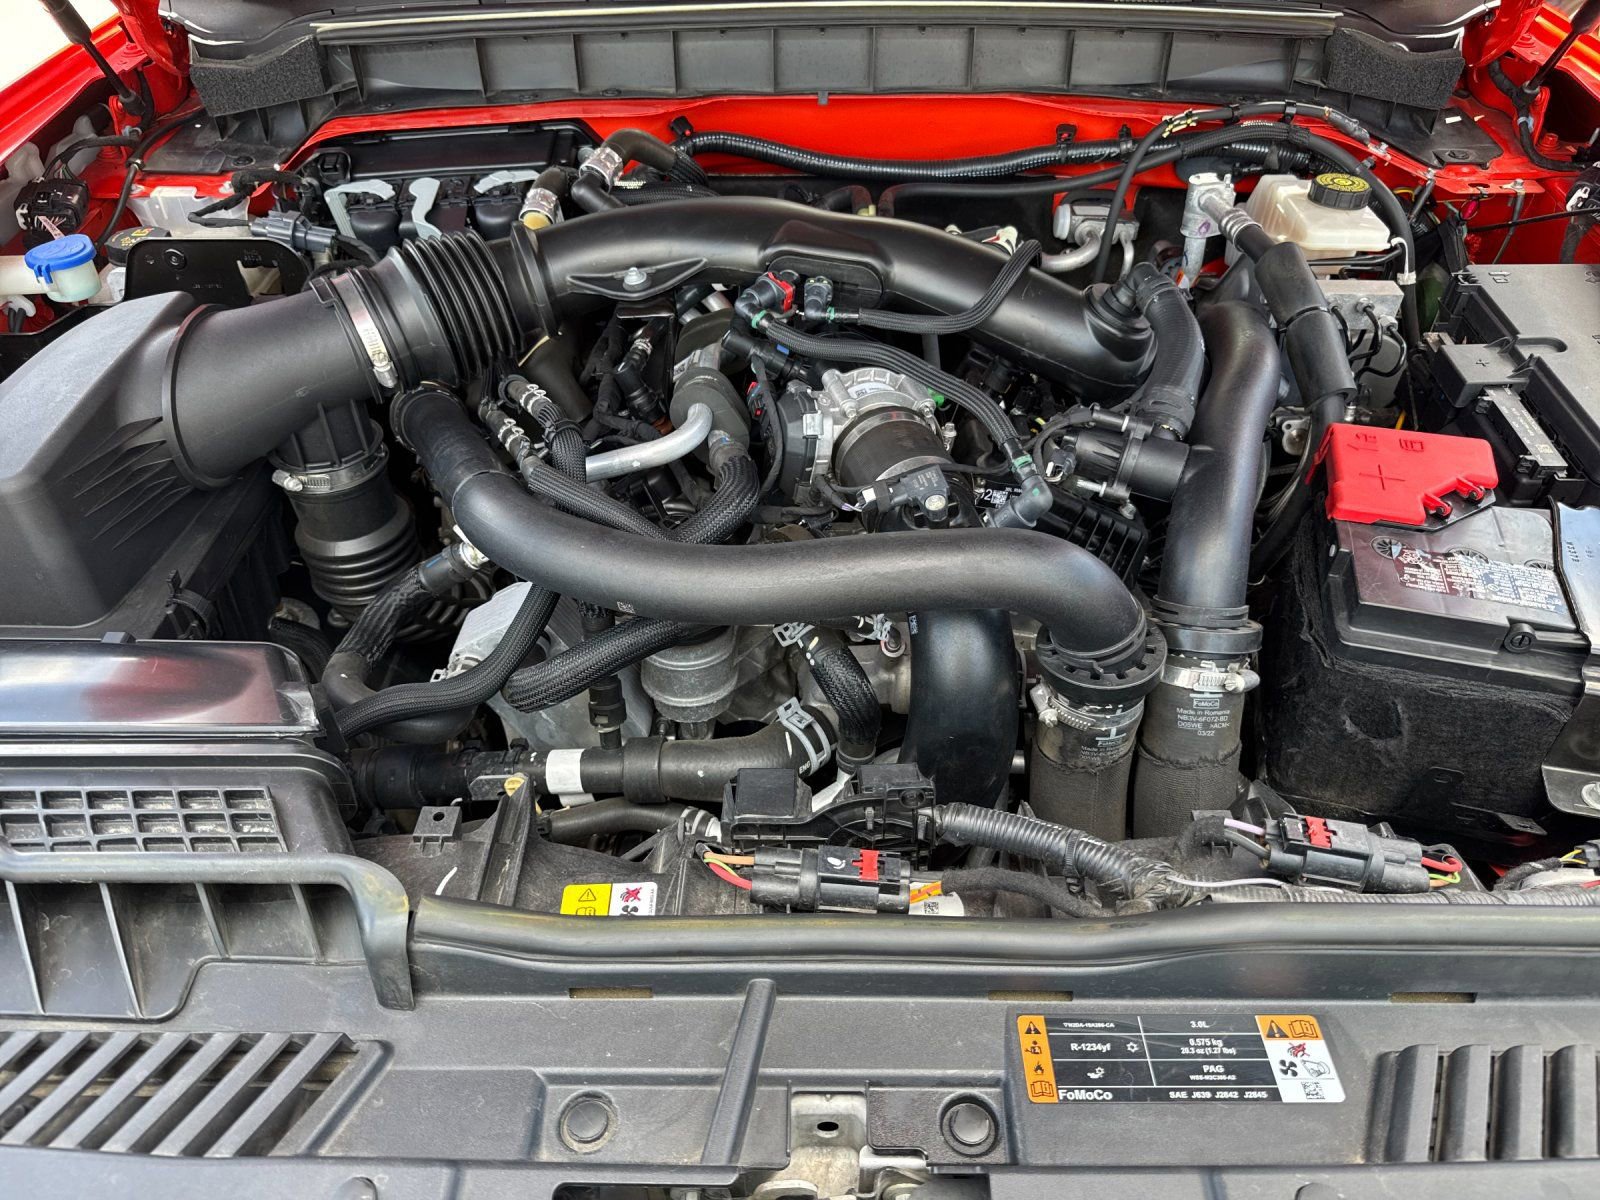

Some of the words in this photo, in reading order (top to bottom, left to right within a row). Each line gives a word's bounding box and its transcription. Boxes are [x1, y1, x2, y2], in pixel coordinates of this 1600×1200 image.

[1176, 707, 1196, 715] Made
[1190, 1020, 1210, 1028] 3.0L
[1188, 1037, 1211, 1047] 0.575
[1211, 1037, 1224, 1048] kg
[1070, 1042, 1111, 1053] R-1234yf
[1202, 1064, 1225, 1073] PAG
[1058, 1089, 1113, 1100] FoMoCo
[1169, 1091, 1189, 1099] SAE
[1191, 1091, 1212, 1099] J639
